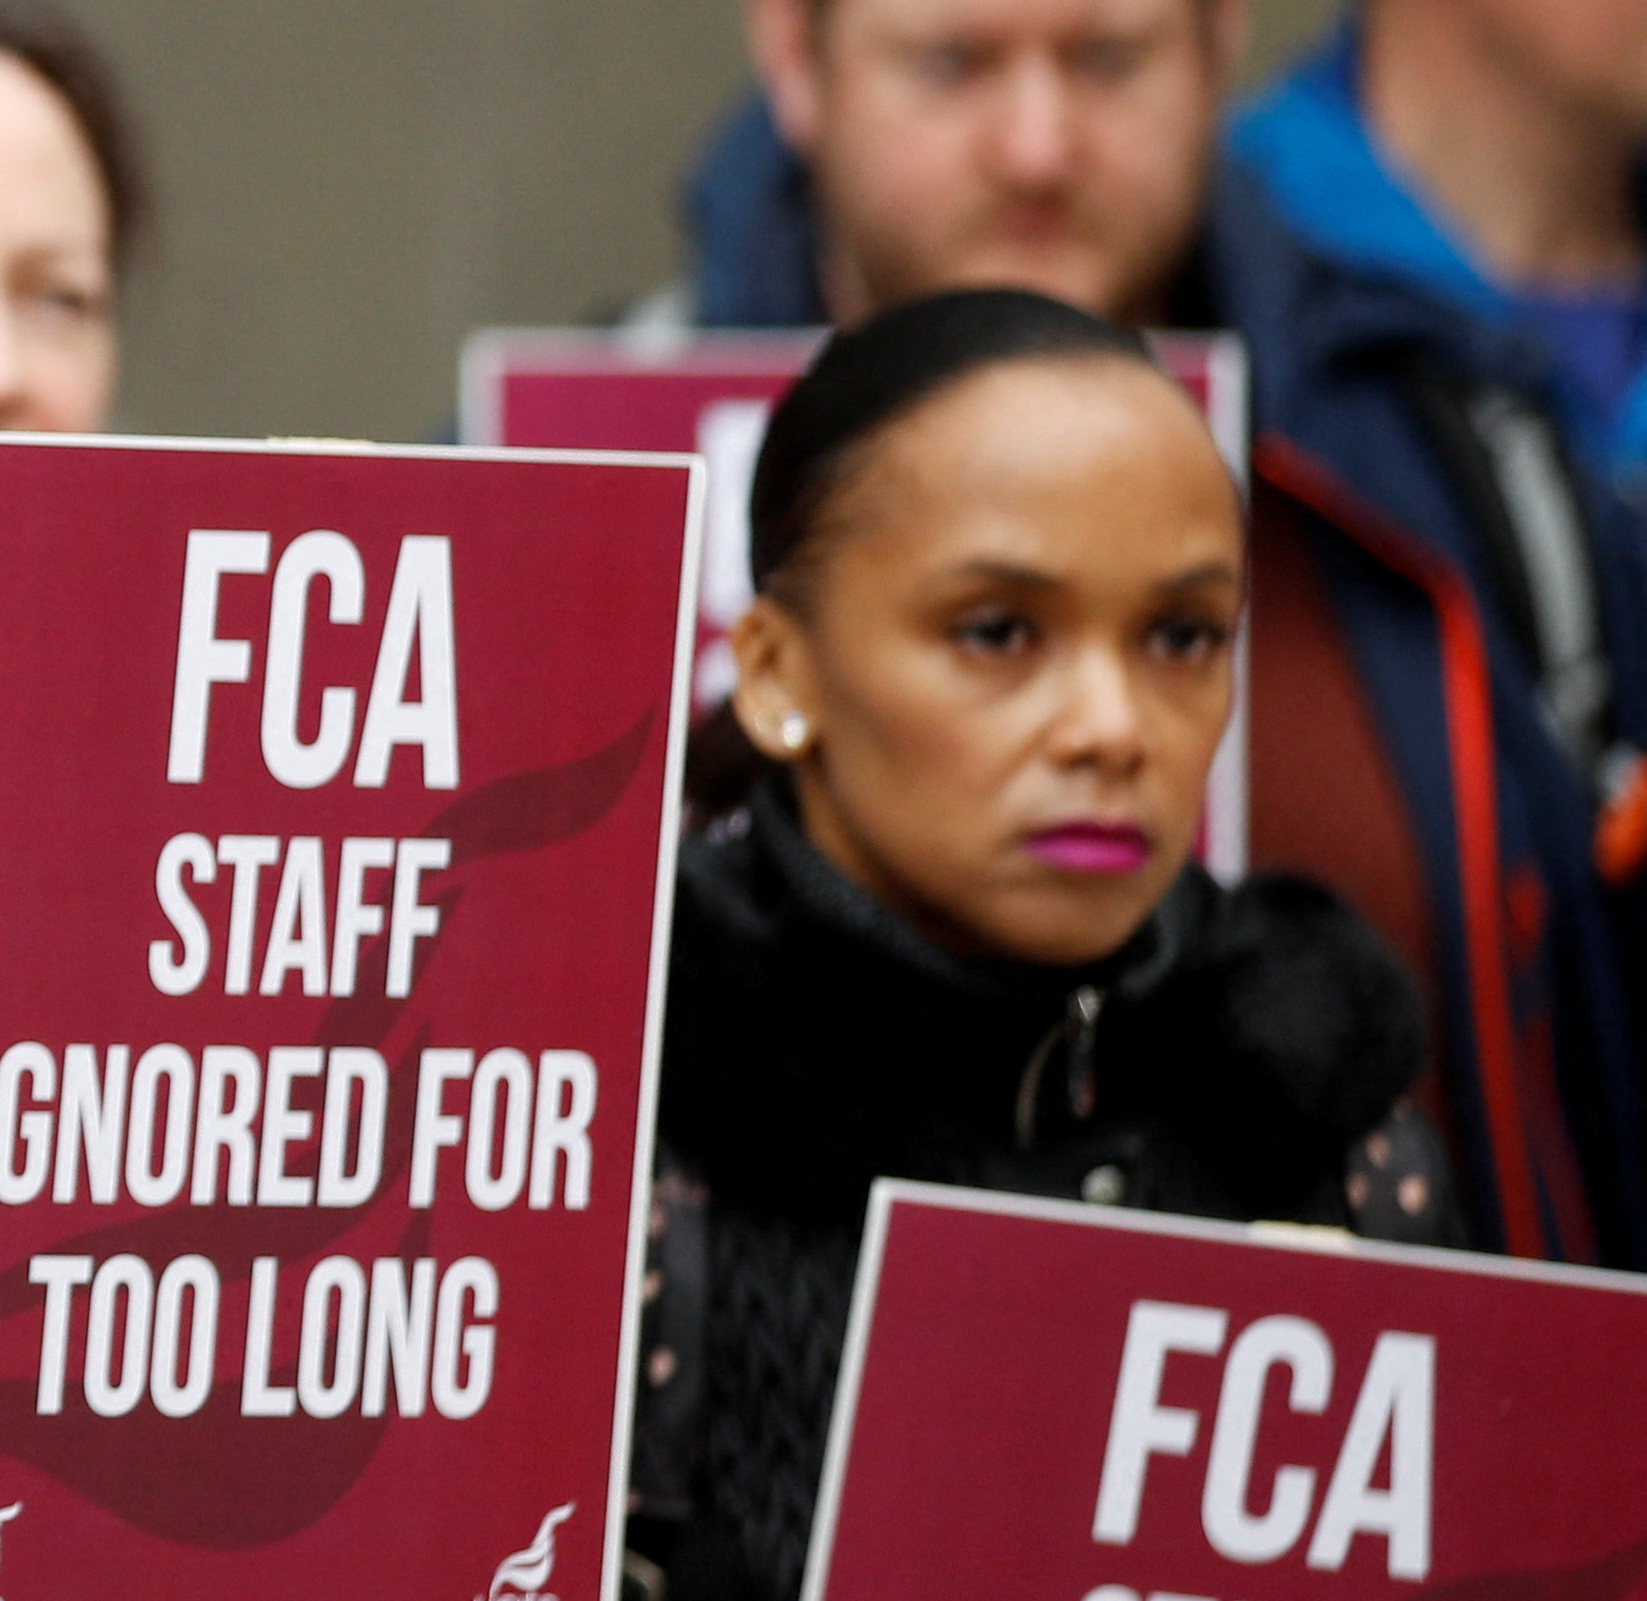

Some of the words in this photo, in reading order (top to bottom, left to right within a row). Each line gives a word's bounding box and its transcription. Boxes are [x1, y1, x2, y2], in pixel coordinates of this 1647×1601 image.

[166, 527, 461, 791] FCA
[147, 831, 452, 999] STAFF
[407, 1046, 599, 1212] FOR
[27, 1252, 221, 1419] TOO
[239, 1254, 500, 1421] LONG
[1091, 1299, 1437, 1584] FCA
